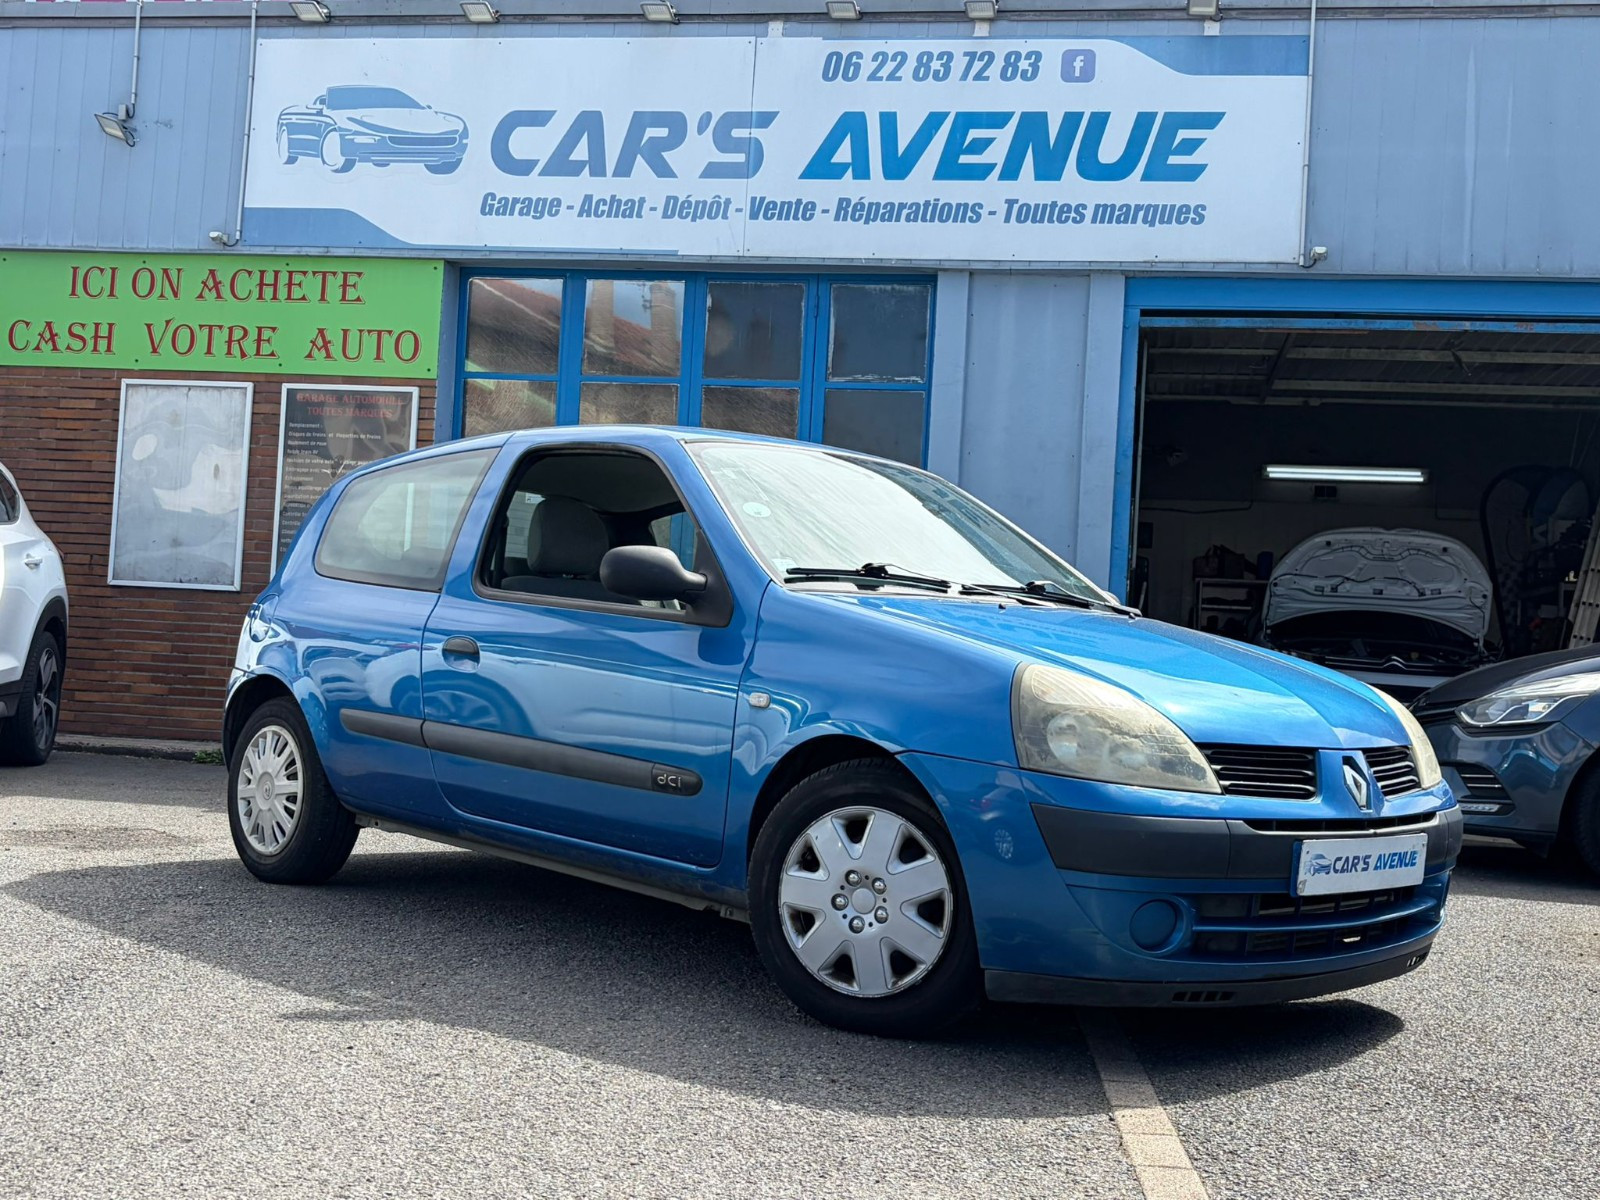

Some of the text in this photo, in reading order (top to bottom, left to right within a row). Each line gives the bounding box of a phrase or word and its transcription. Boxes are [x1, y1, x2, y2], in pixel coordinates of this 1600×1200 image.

[822, 50, 1043, 82] 06 22 83 72 83
[490, 110, 1227, 182] CAR'S AVENUE
[480, 192, 562, 220] Garage
[577, 194, 646, 220] Achat
[661, 194, 732, 222] Dépôt
[748, 196, 817, 221] Vente
[834, 196, 985, 225] Réparations
[1003, 198, 1086, 224] Toutes
[1091, 202, 1207, 228] marques
[68, 265, 366, 305] ICI ON ACHETE
[7, 317, 422, 364] CASH VOTRE AUTO
[296, 392, 340, 403] GARAGE
[307, 406, 343, 417] TOUTES
[1332, 850, 1418, 875] CAR'S AVENUE
